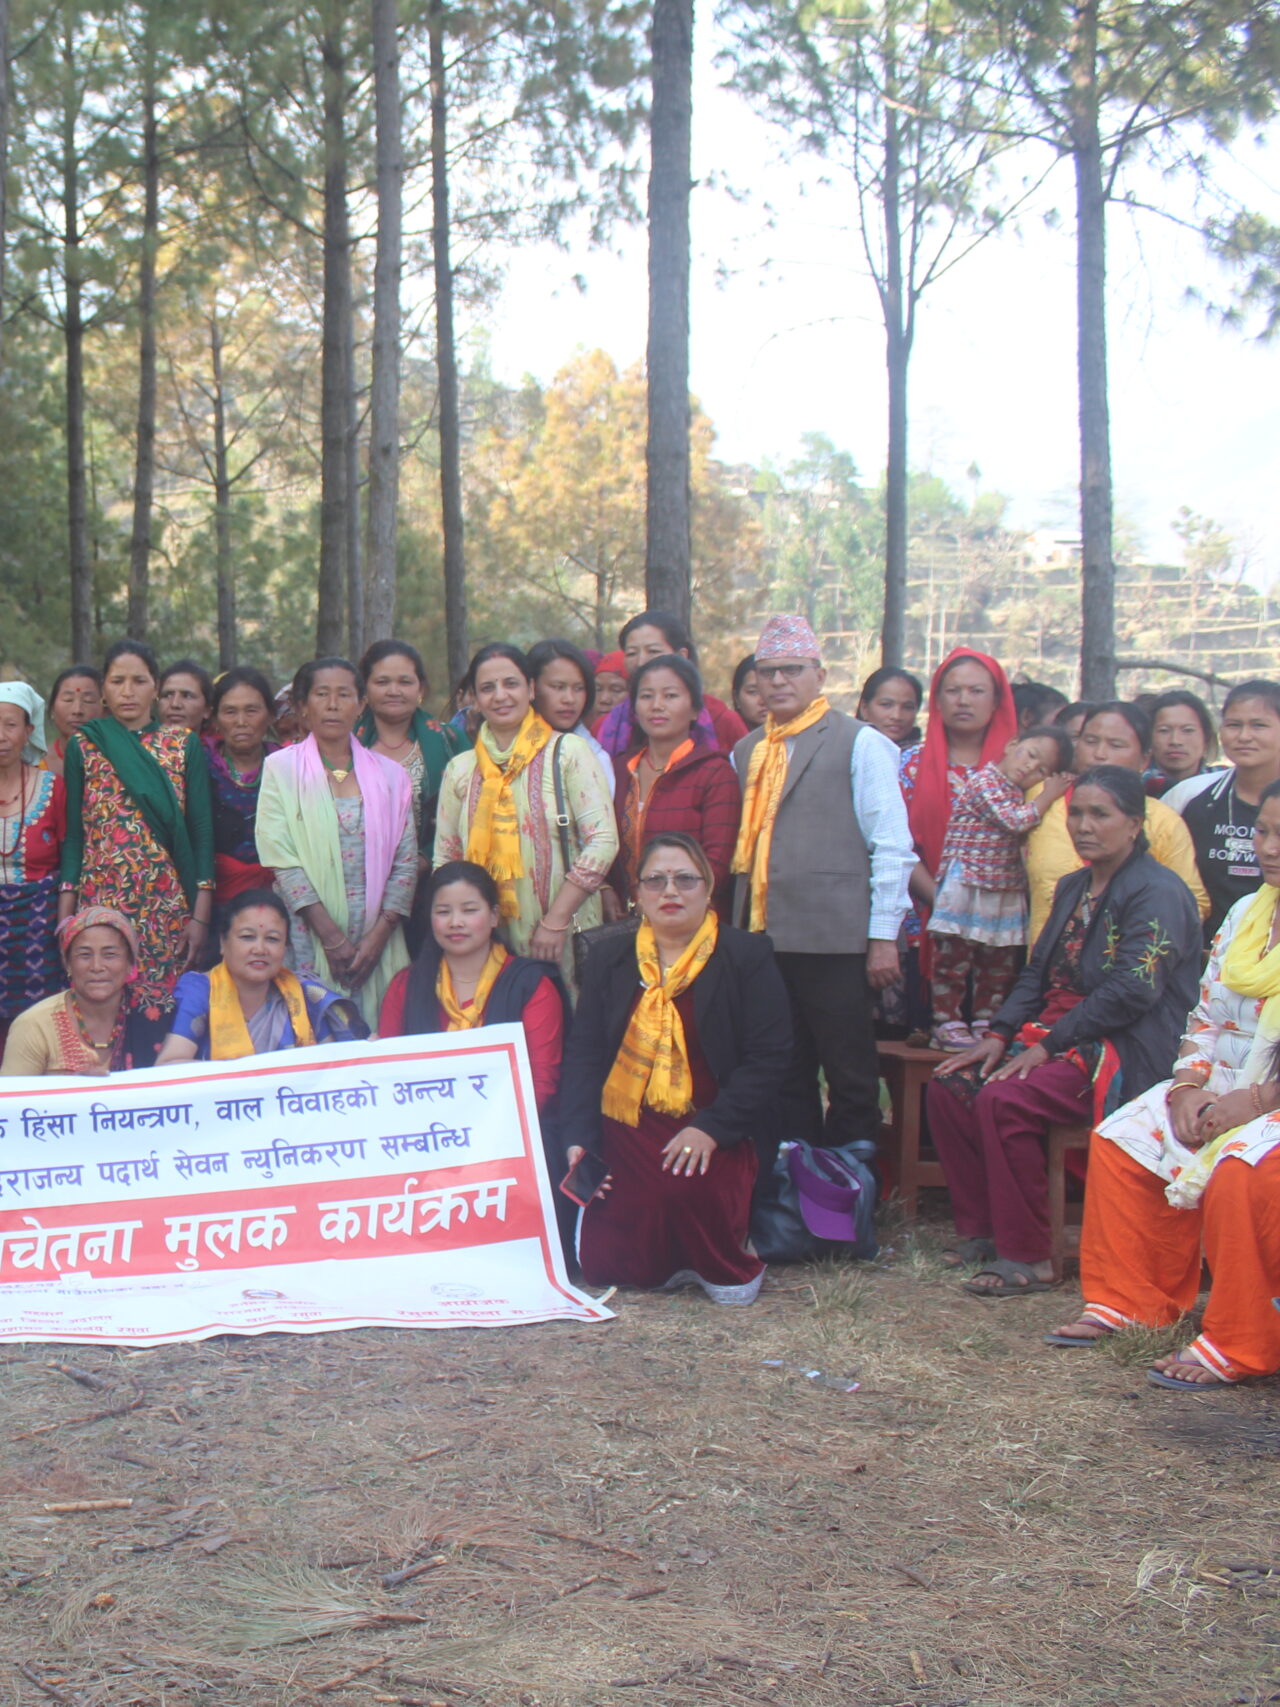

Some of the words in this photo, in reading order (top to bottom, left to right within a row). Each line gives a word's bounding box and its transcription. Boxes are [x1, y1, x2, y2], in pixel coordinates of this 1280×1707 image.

[20, 1107, 77, 1142] हिंसा
[215, 1097, 265, 1122] वाल
[277, 1080, 379, 1116] विवाहको
[393, 1077, 456, 1105] अन्त्य
[469, 1074, 488, 1100] र
[97, 1150, 160, 1187] पदार्थ
[174, 1149, 229, 1180] सेवन
[242, 1138, 367, 1179] न्युनिकरण
[379, 1121, 473, 1161] सम्बन्धि
[163, 1205, 297, 1272] मुलक
[317, 1177, 518, 1244] कार्यक्रम
